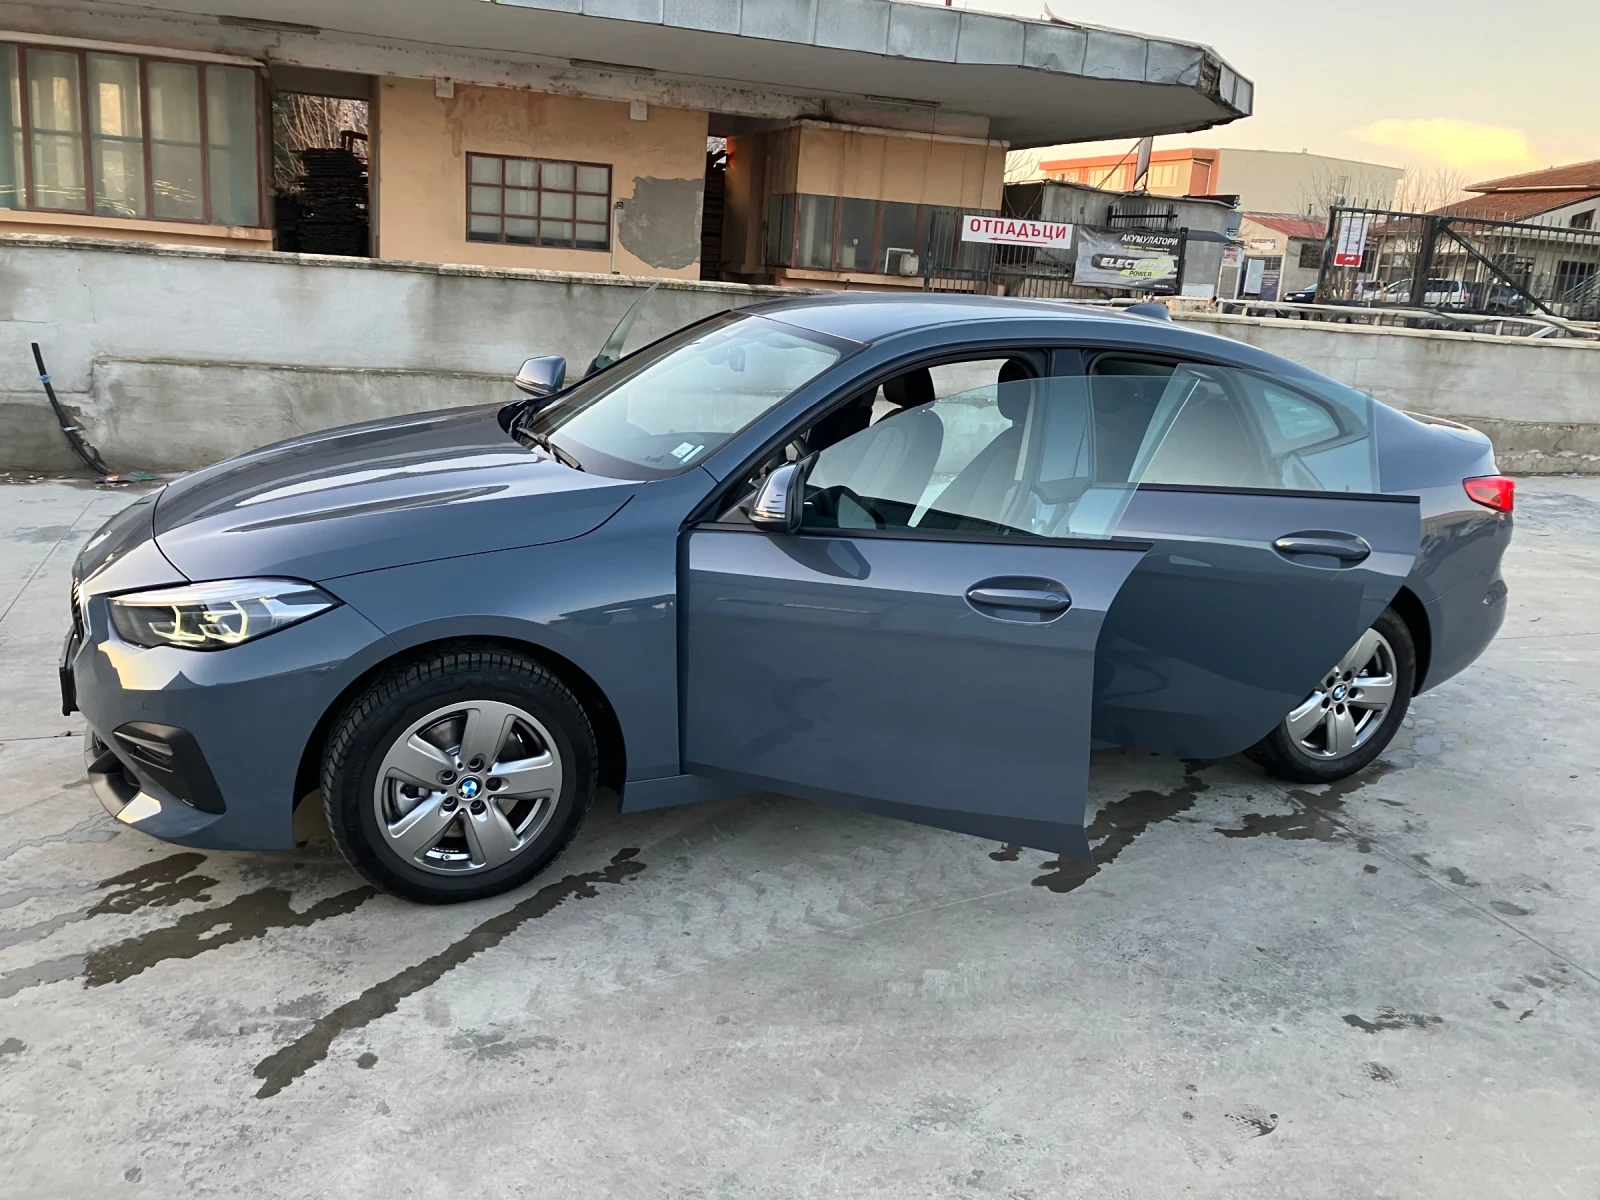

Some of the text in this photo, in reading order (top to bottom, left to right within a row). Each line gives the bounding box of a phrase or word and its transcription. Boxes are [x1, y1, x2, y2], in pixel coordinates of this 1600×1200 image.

[970, 218, 1067, 240] ОТПАДЪЦИ
[1121, 233, 1178, 246] АКУМУЛАТОРИ
[1129, 269, 1152, 277] POWER
